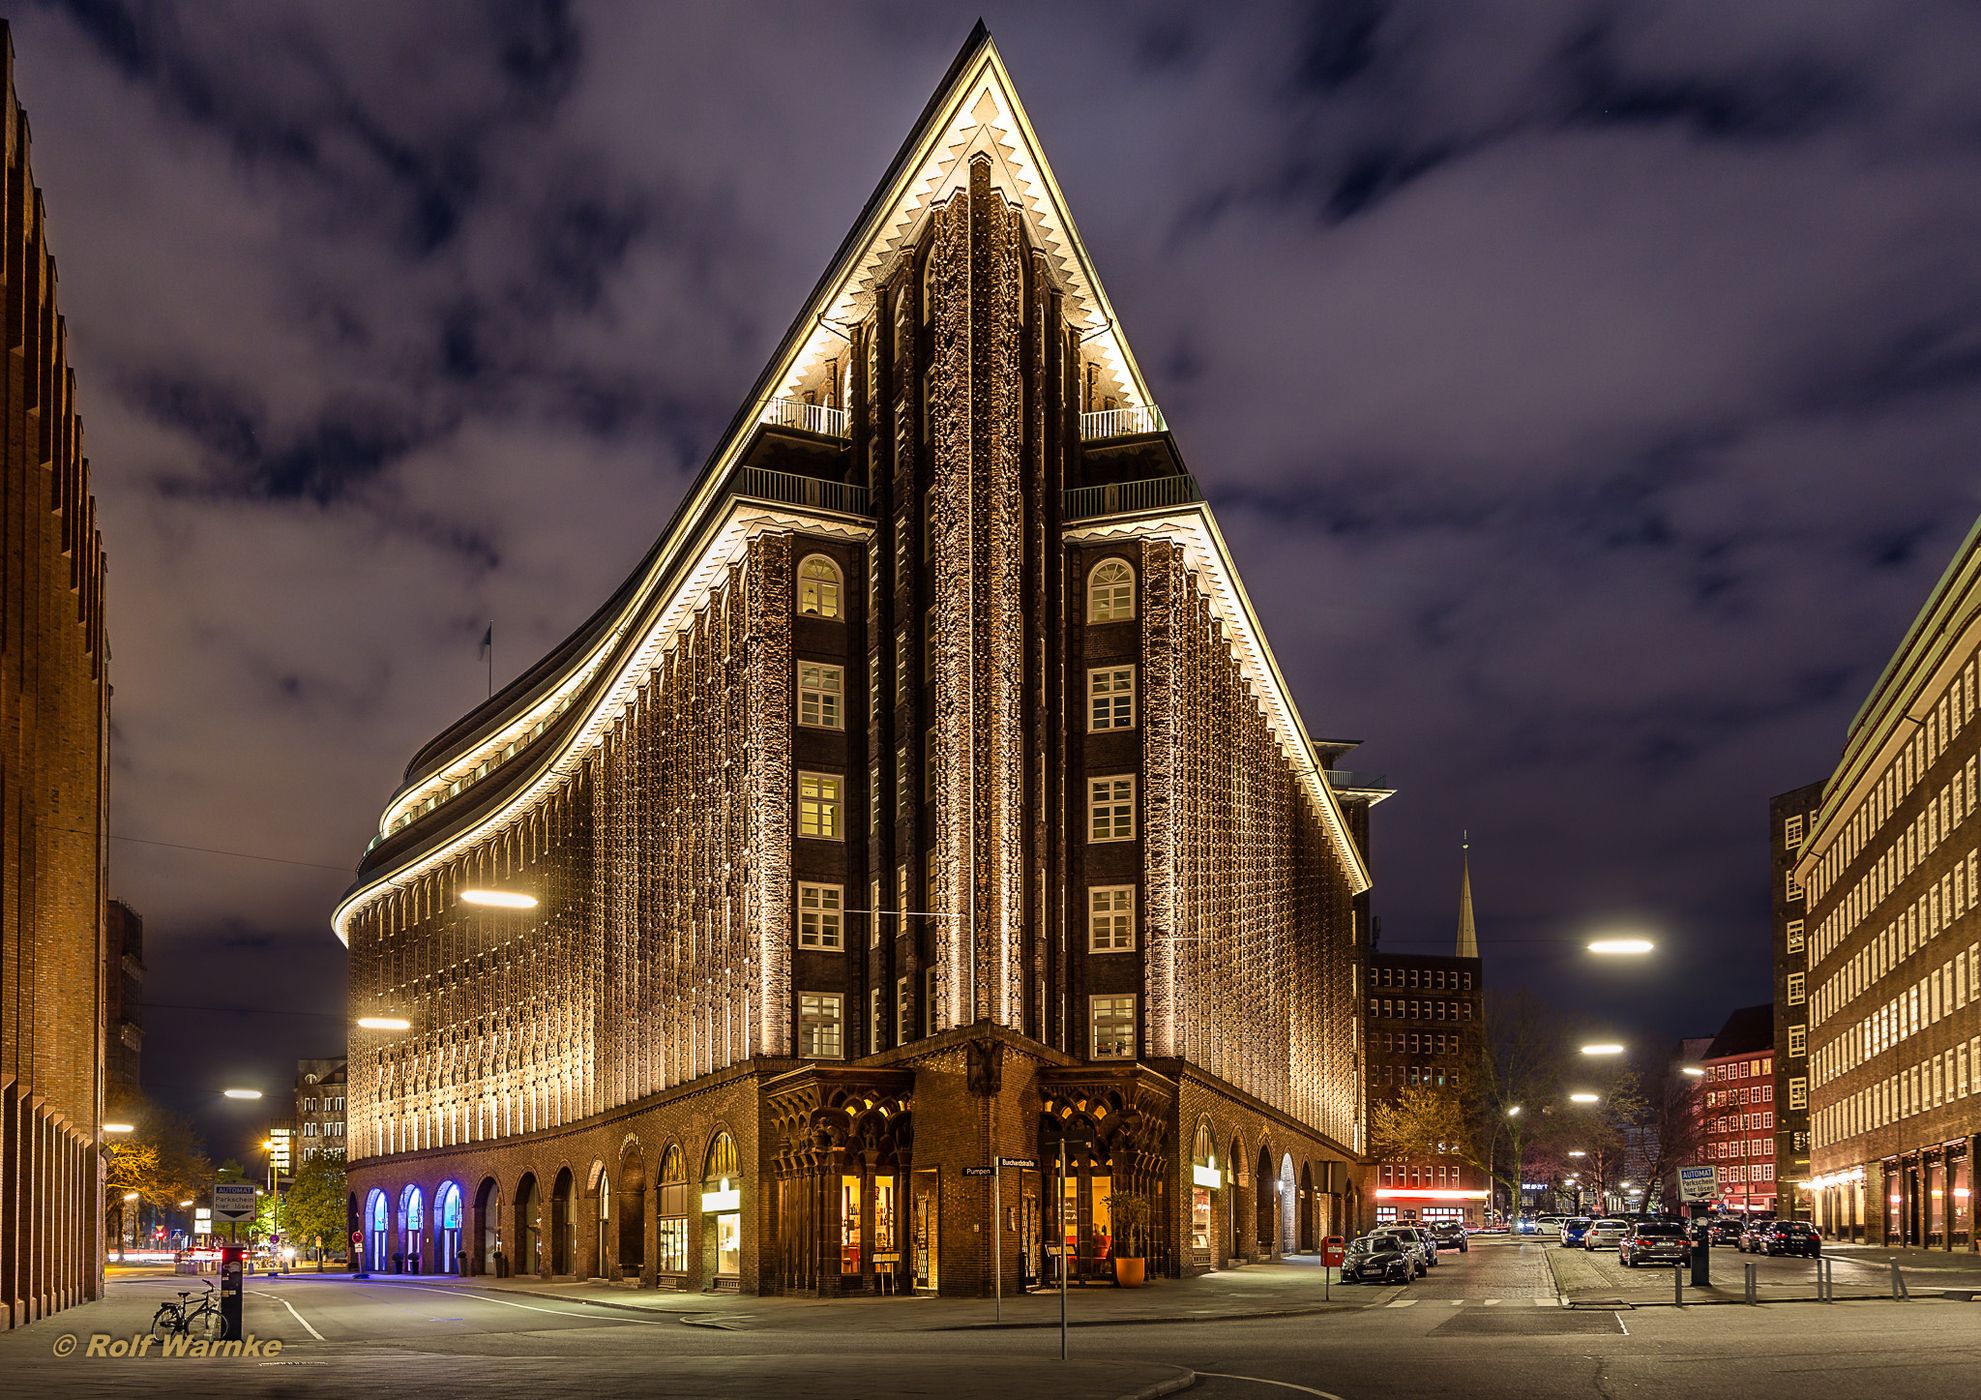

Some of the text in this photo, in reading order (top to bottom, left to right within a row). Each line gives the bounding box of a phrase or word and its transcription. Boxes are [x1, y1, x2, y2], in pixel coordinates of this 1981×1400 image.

[1682, 1169, 1712, 1179] AUTOMAT
[1682, 1178, 1714, 1186] Parkschein
[1697, 1185, 1715, 1193] lösen
